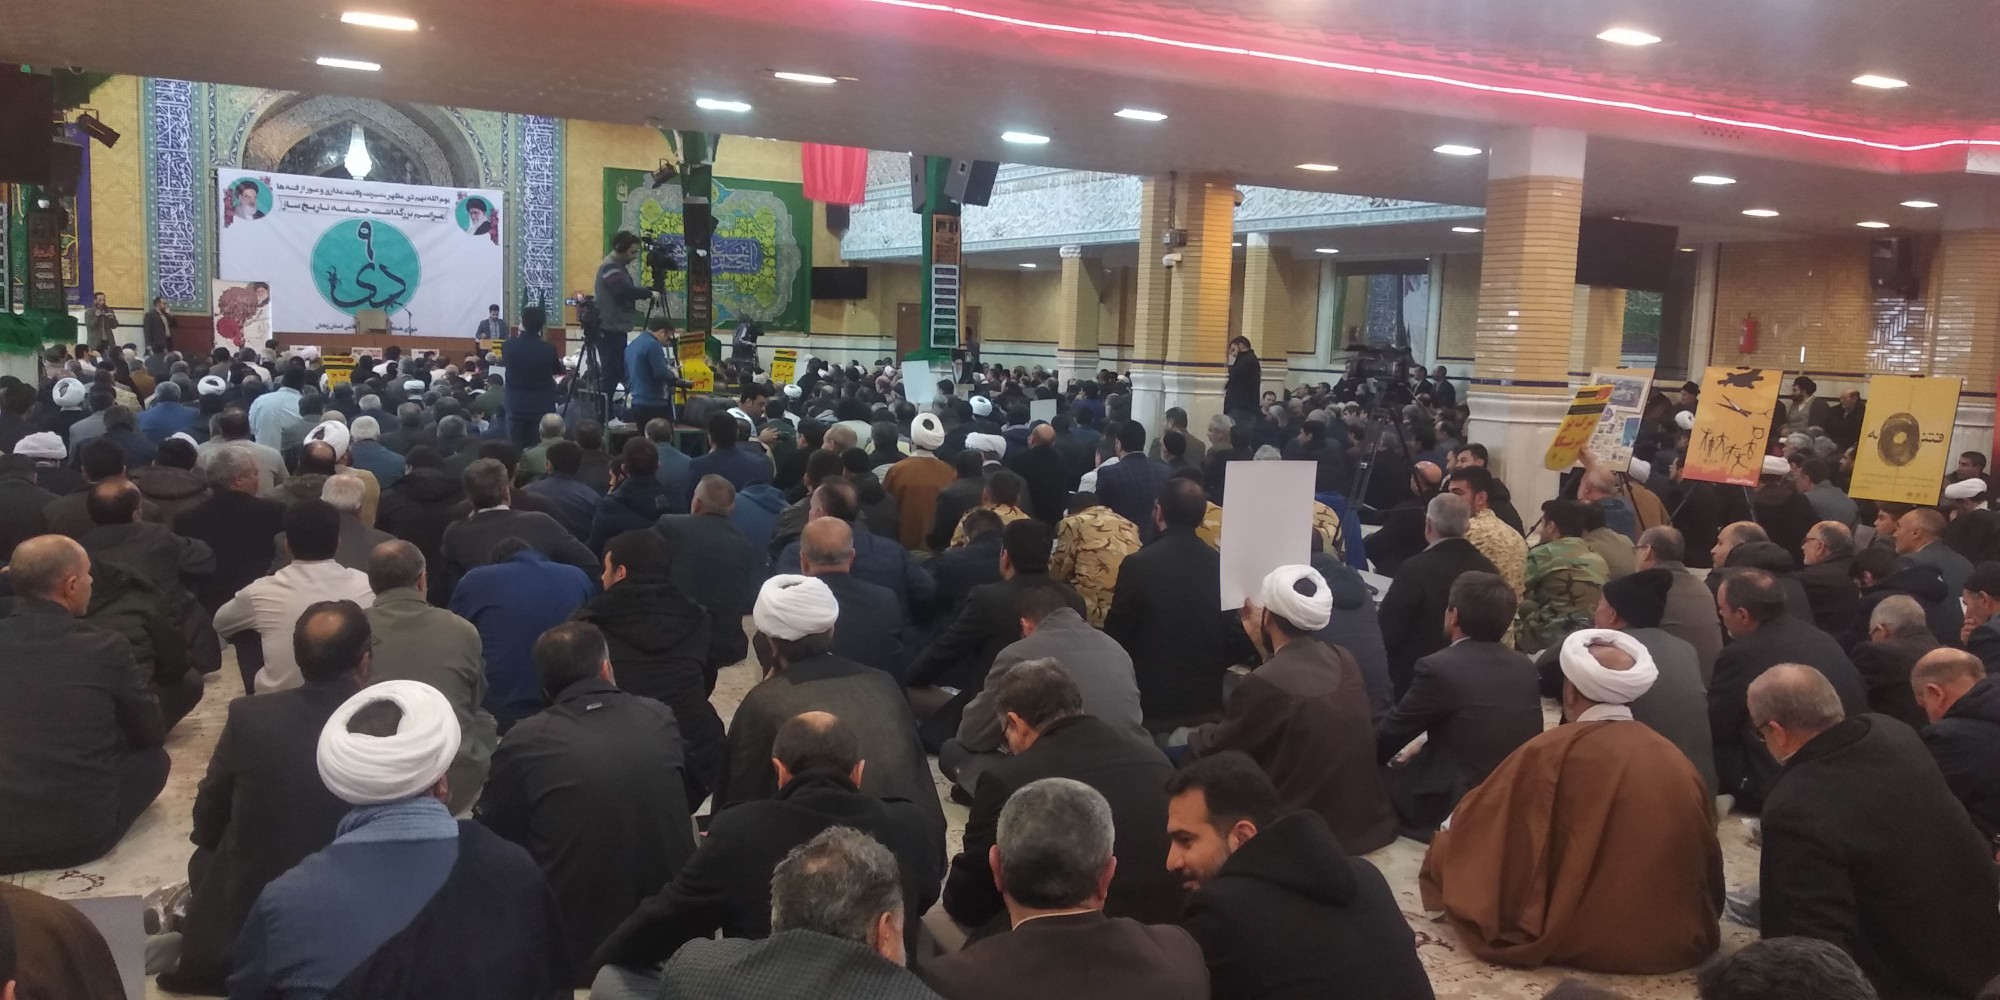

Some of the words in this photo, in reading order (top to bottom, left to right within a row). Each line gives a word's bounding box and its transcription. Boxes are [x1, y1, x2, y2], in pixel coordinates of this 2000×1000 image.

[281, 200, 300, 210] ساز
[302, 201, 329, 214] تاریخ
[331, 204, 371, 214] حماسه
[371, 207, 413, 219] بزرگداشت
[414, 211, 445, 221] مراسم
[358, 221, 374, 260] ۹
[327, 262, 406, 308] دی
